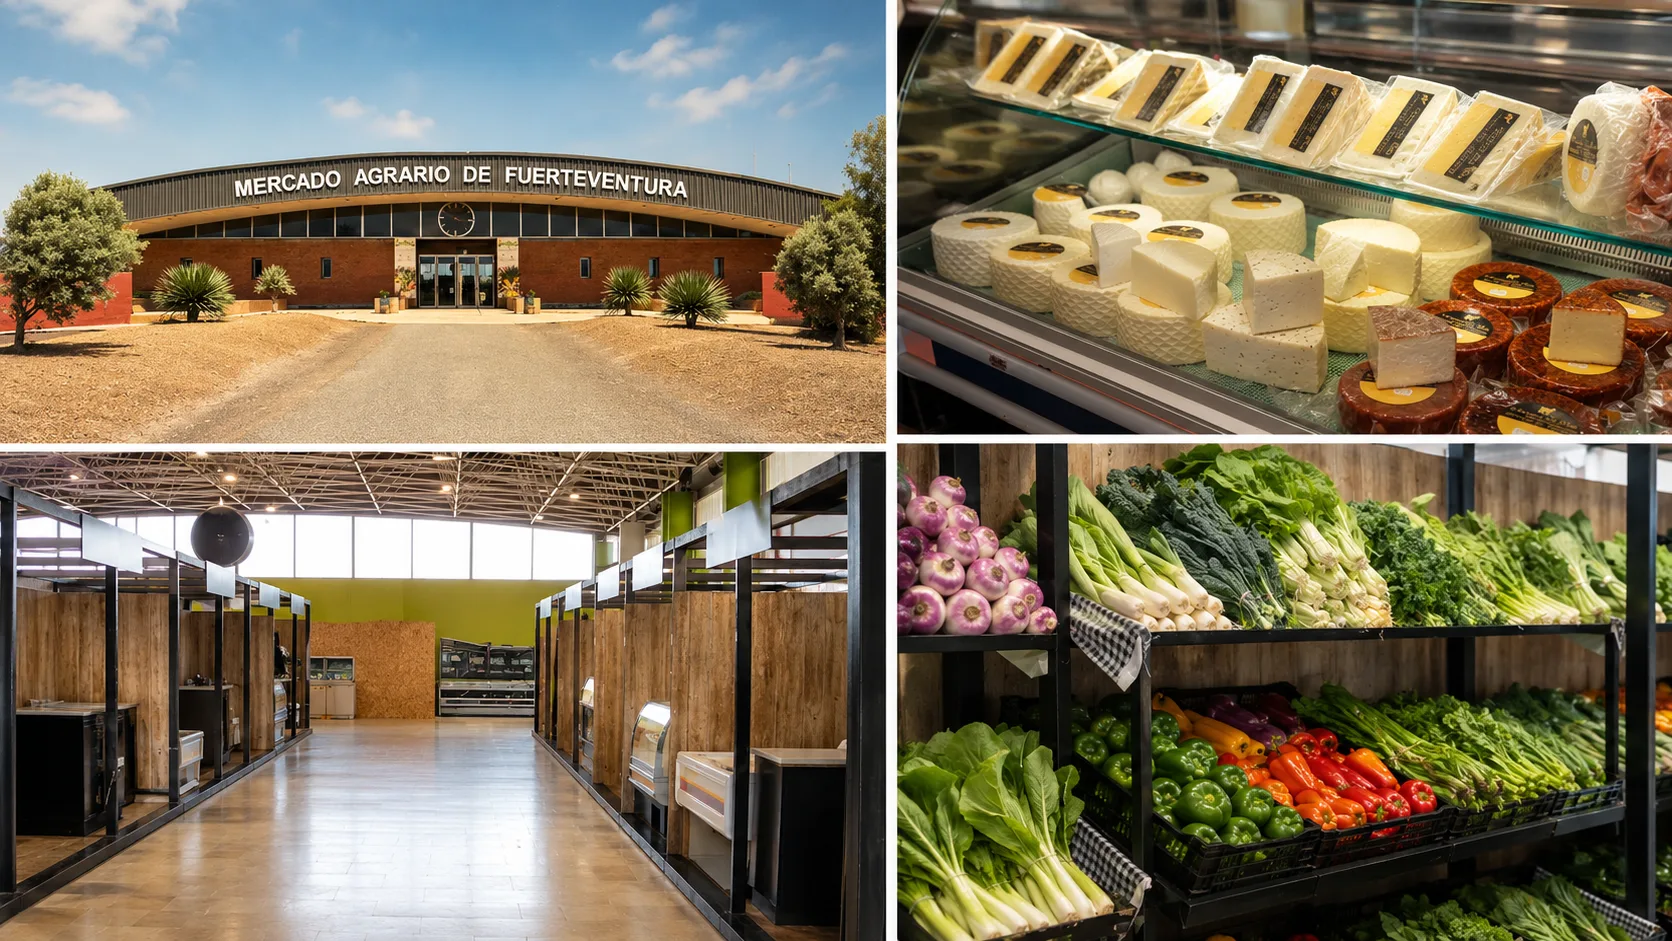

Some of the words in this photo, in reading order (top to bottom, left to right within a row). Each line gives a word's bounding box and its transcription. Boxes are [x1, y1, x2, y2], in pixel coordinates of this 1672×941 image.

[234, 170, 341, 198] MERCADO
[353, 165, 451, 186] AGRARIO
[463, 165, 491, 183] DE
[505, 166, 688, 198] FUERTEVENTURA
